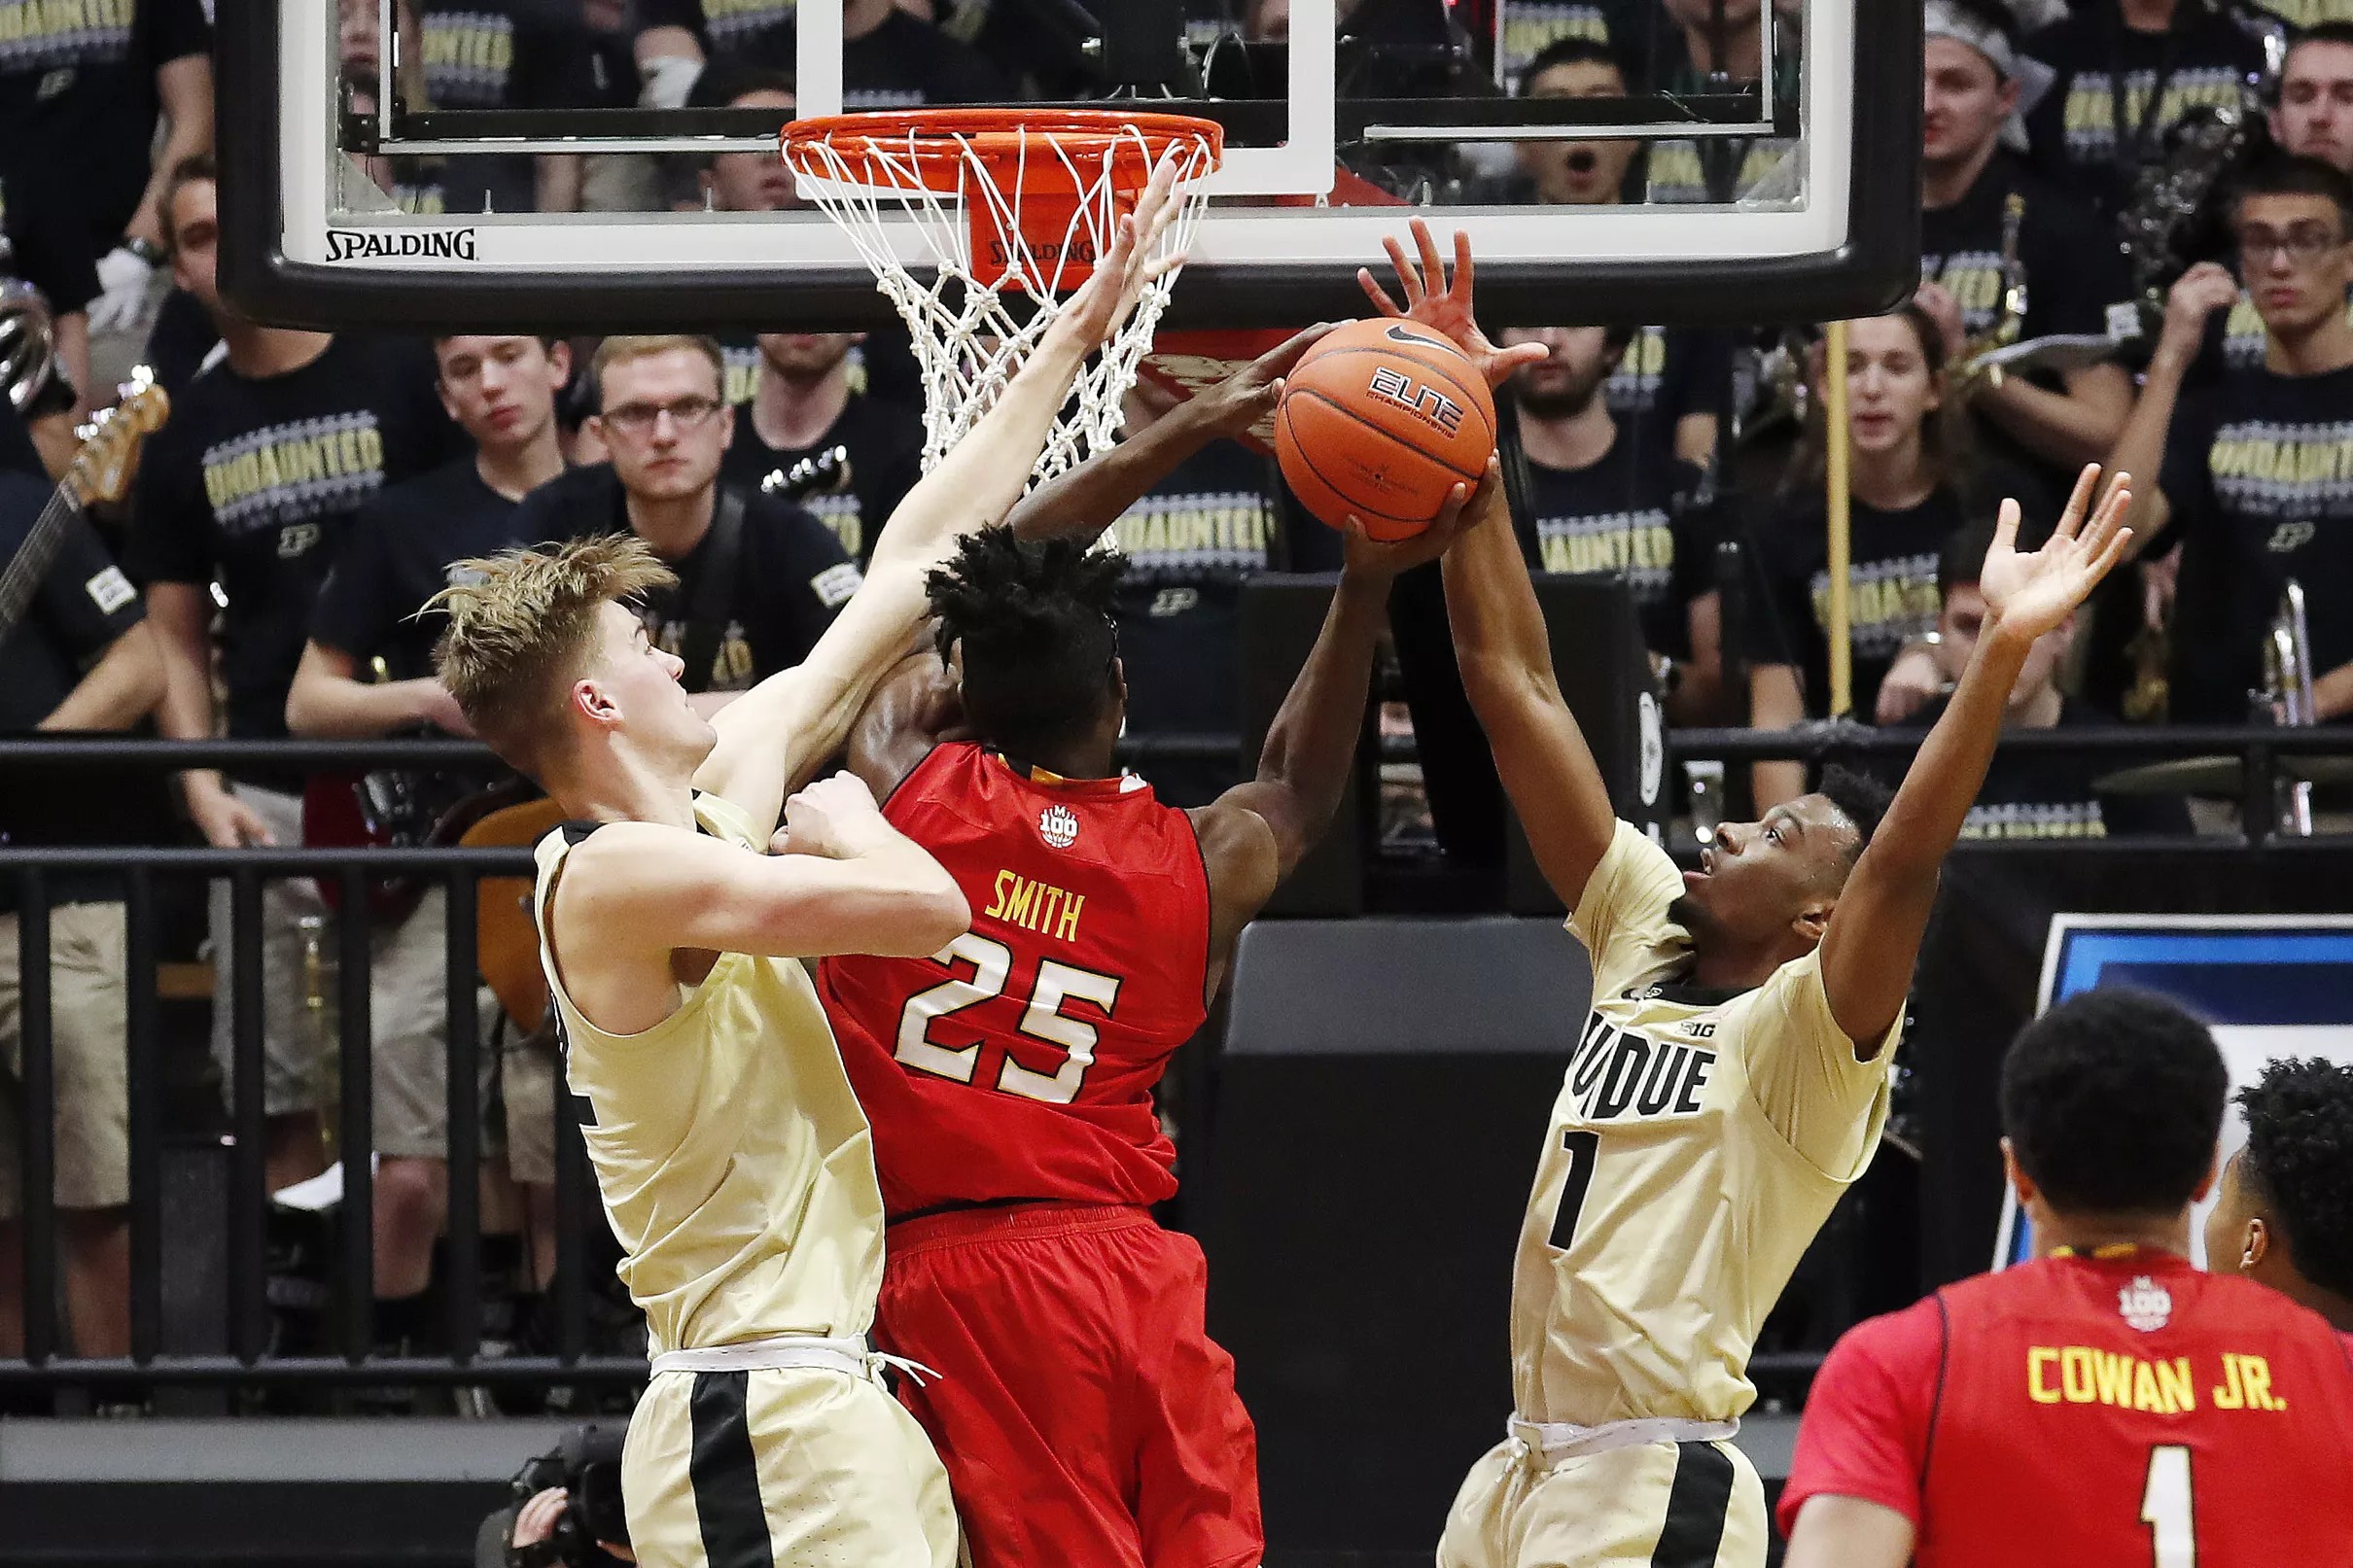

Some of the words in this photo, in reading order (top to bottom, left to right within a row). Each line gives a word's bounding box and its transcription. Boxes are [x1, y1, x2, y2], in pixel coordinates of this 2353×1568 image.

[326, 227, 475, 262] SPALDING
[1365, 391, 1456, 439] CHAMPIONSHIP
[1368, 366, 1464, 432] ELITE
[1039, 812, 1079, 839] 100
[984, 869, 1086, 943] SMITH
[893, 930, 1124, 1105] 25
[1548, 1130, 1601, 1252] 1
[2026, 1345, 2197, 1414] COWAN
[2212, 1351, 2288, 1411] JR.
[2139, 1443, 2197, 1568] 1
